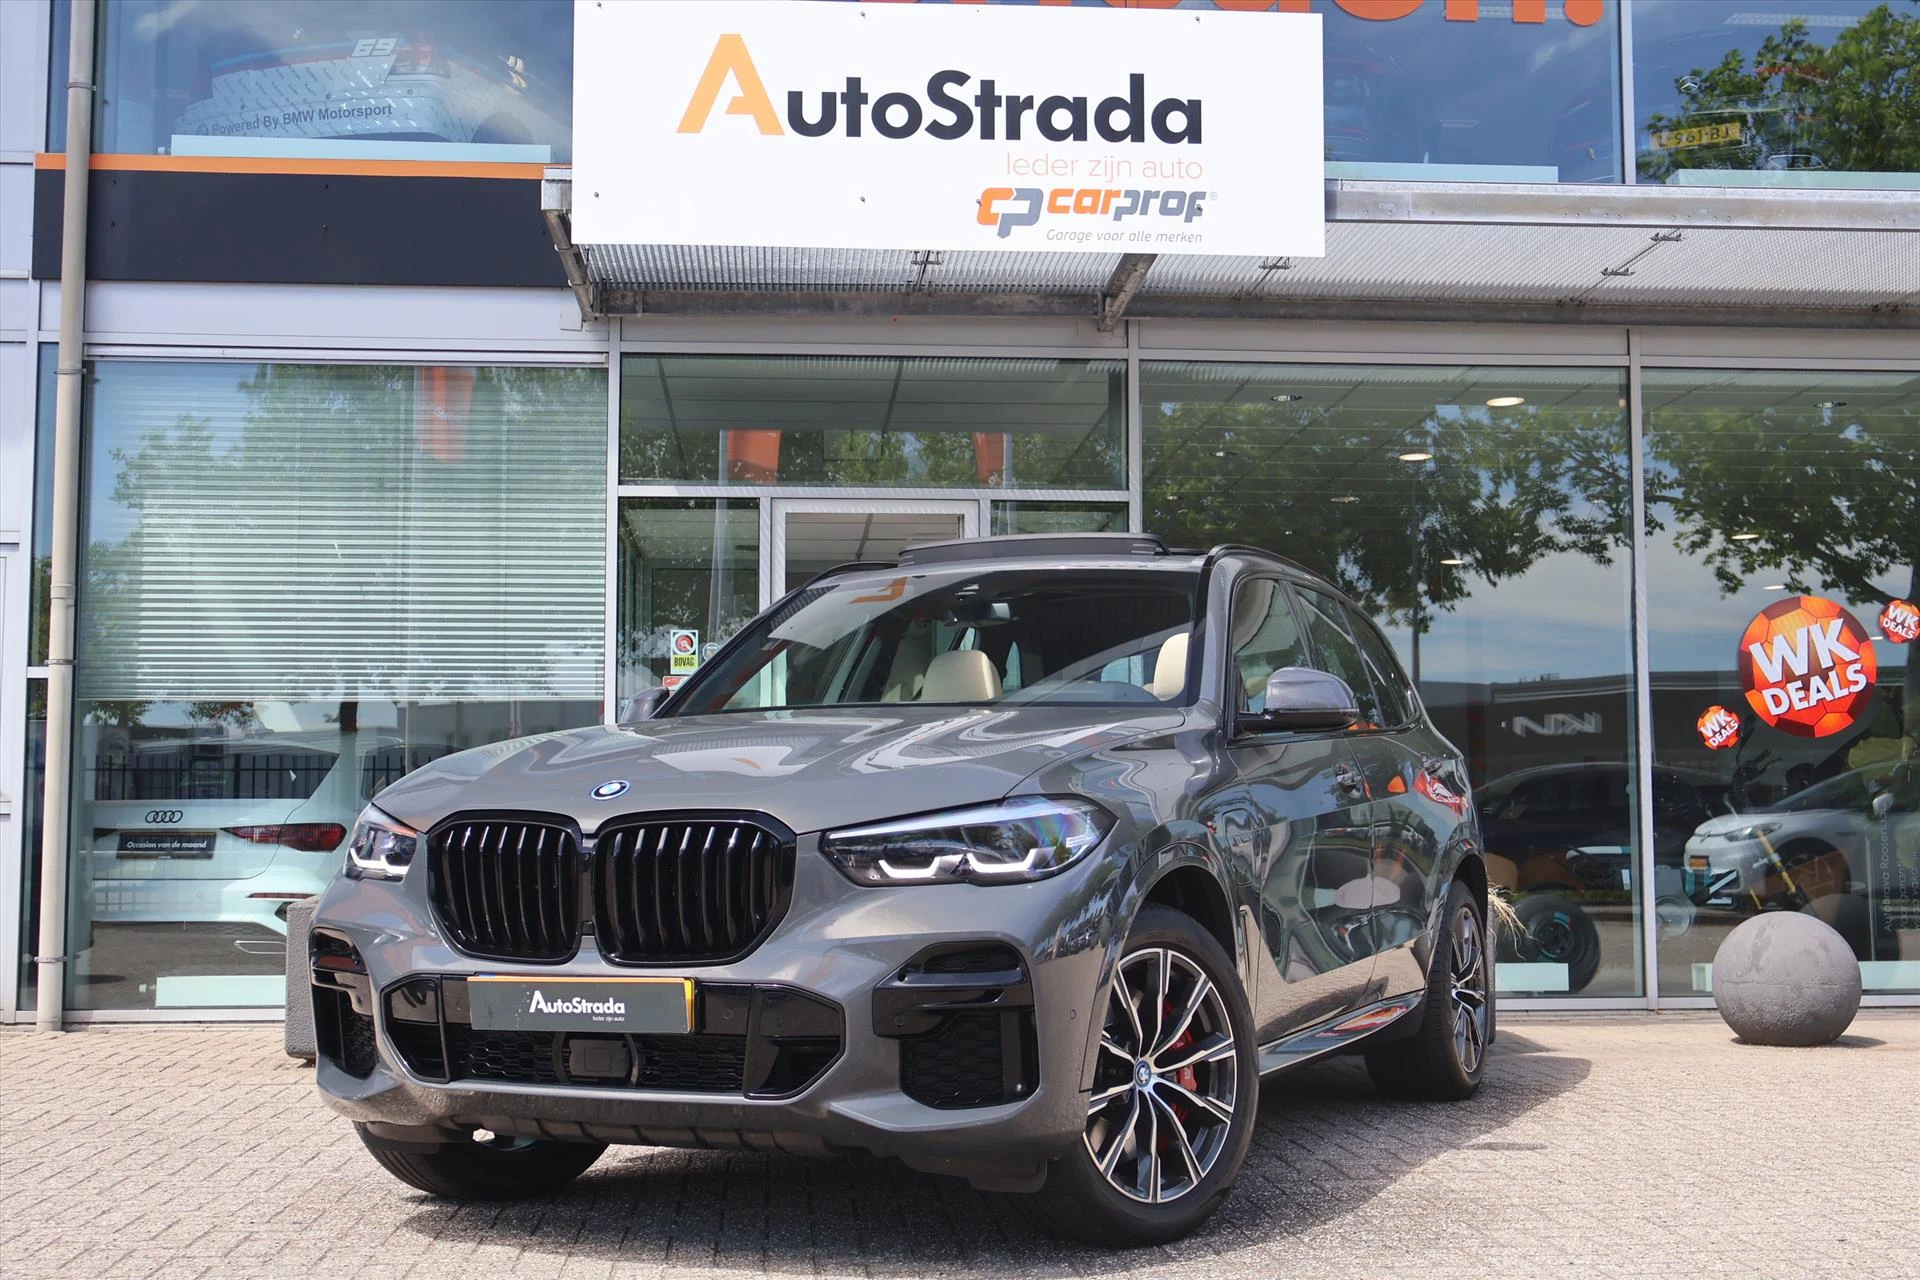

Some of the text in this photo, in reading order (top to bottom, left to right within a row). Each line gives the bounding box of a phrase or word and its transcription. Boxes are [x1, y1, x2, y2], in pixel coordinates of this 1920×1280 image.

[351, 38, 393, 57] 69
[676, 34, 1202, 144] AutoStrada
[212, 104, 393, 135] Powered By BMW Motorsport
[1007, 153, 1203, 182] Ieder zijn auto
[1046, 229, 1203, 244] Garage voor alle merken
[1882, 617, 1915, 639] DEALS
[1889, 604, 1920, 632] WK
[674, 656, 695, 667] BOVAG
[1748, 618, 1861, 684] WK
[1761, 663, 1868, 716] DEALS
[1700, 709, 1733, 738] WK
[1709, 719, 1739, 747] DEALS
[127, 841, 157, 849] Occasion
[172, 841, 181, 849] de
[182, 841, 207, 849] maand
[529, 990, 625, 1014] AutoStrada
